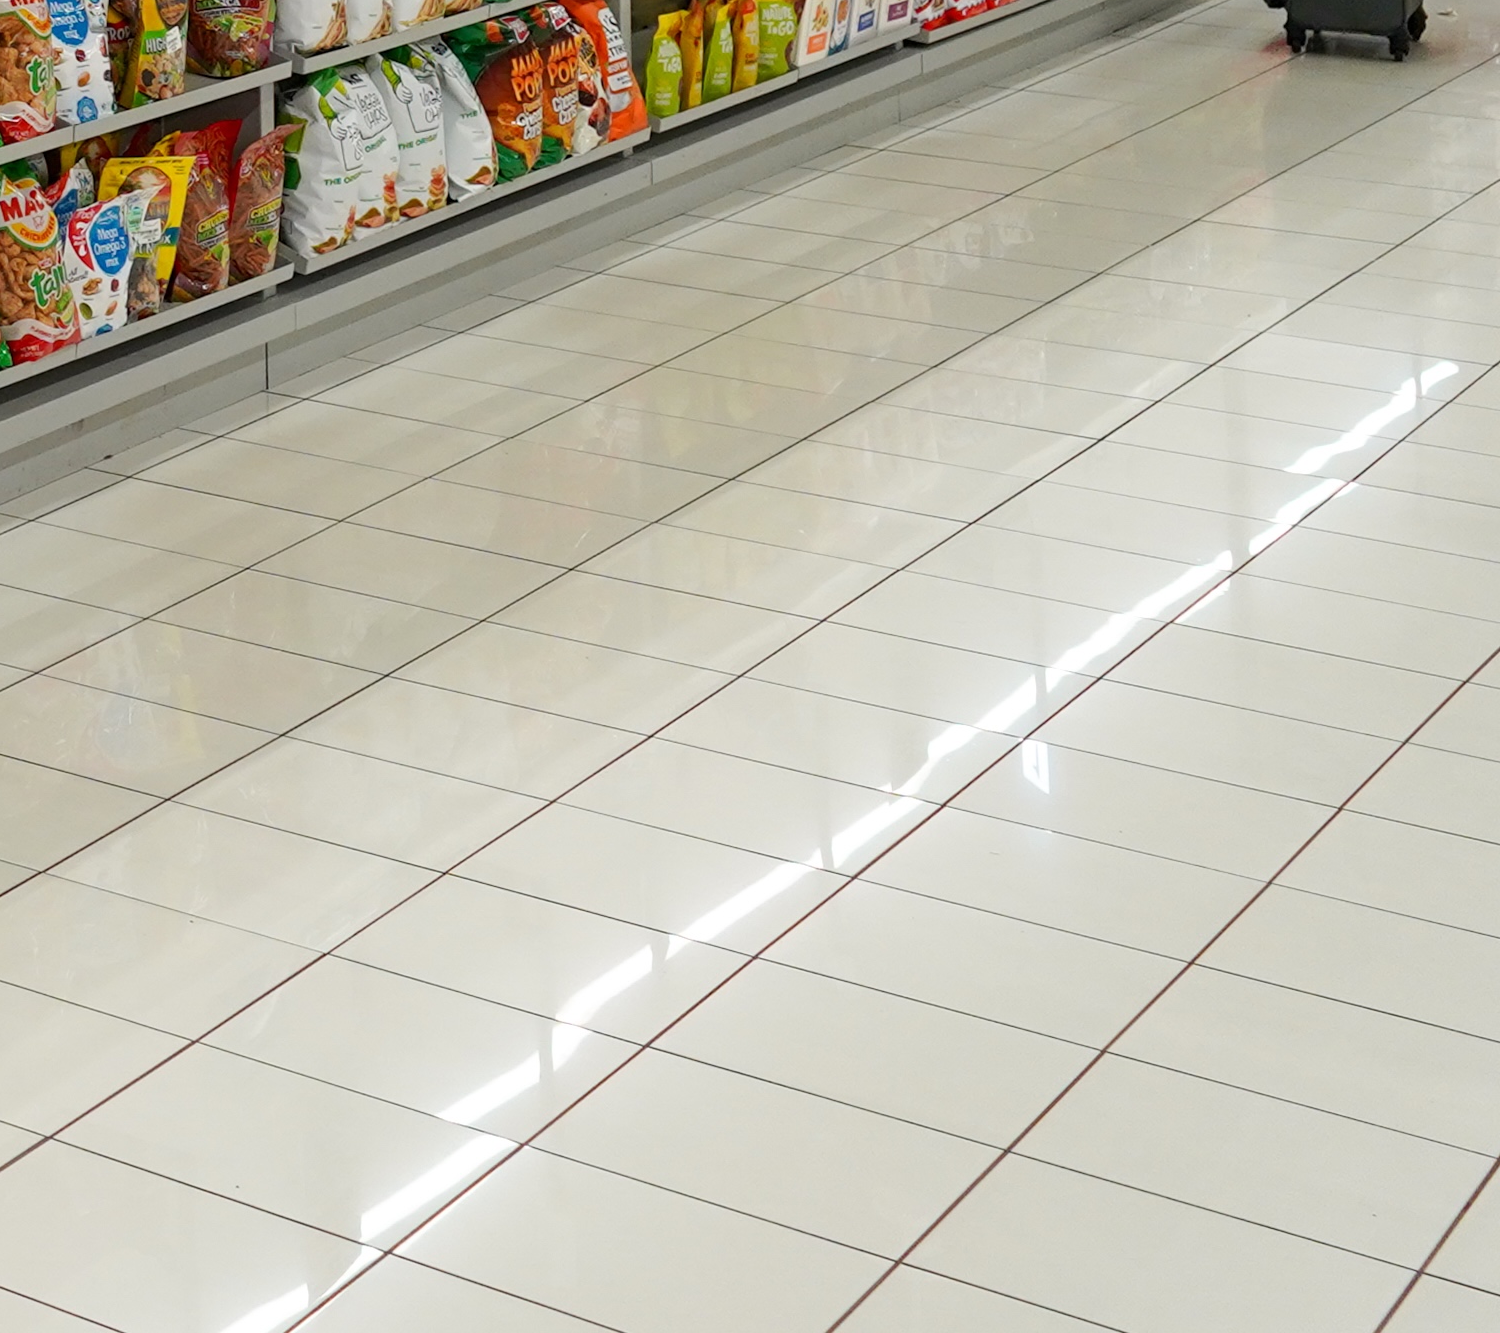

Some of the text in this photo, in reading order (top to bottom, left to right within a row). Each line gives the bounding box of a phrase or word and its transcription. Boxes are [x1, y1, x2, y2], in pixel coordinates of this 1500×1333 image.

[762, 4, 794, 21] NATURE
[460, 109, 478, 119] THE
[96, 228, 119, 241] Mega
[94, 236, 127, 256] Omega 3
[105, 257, 119, 268] mix
